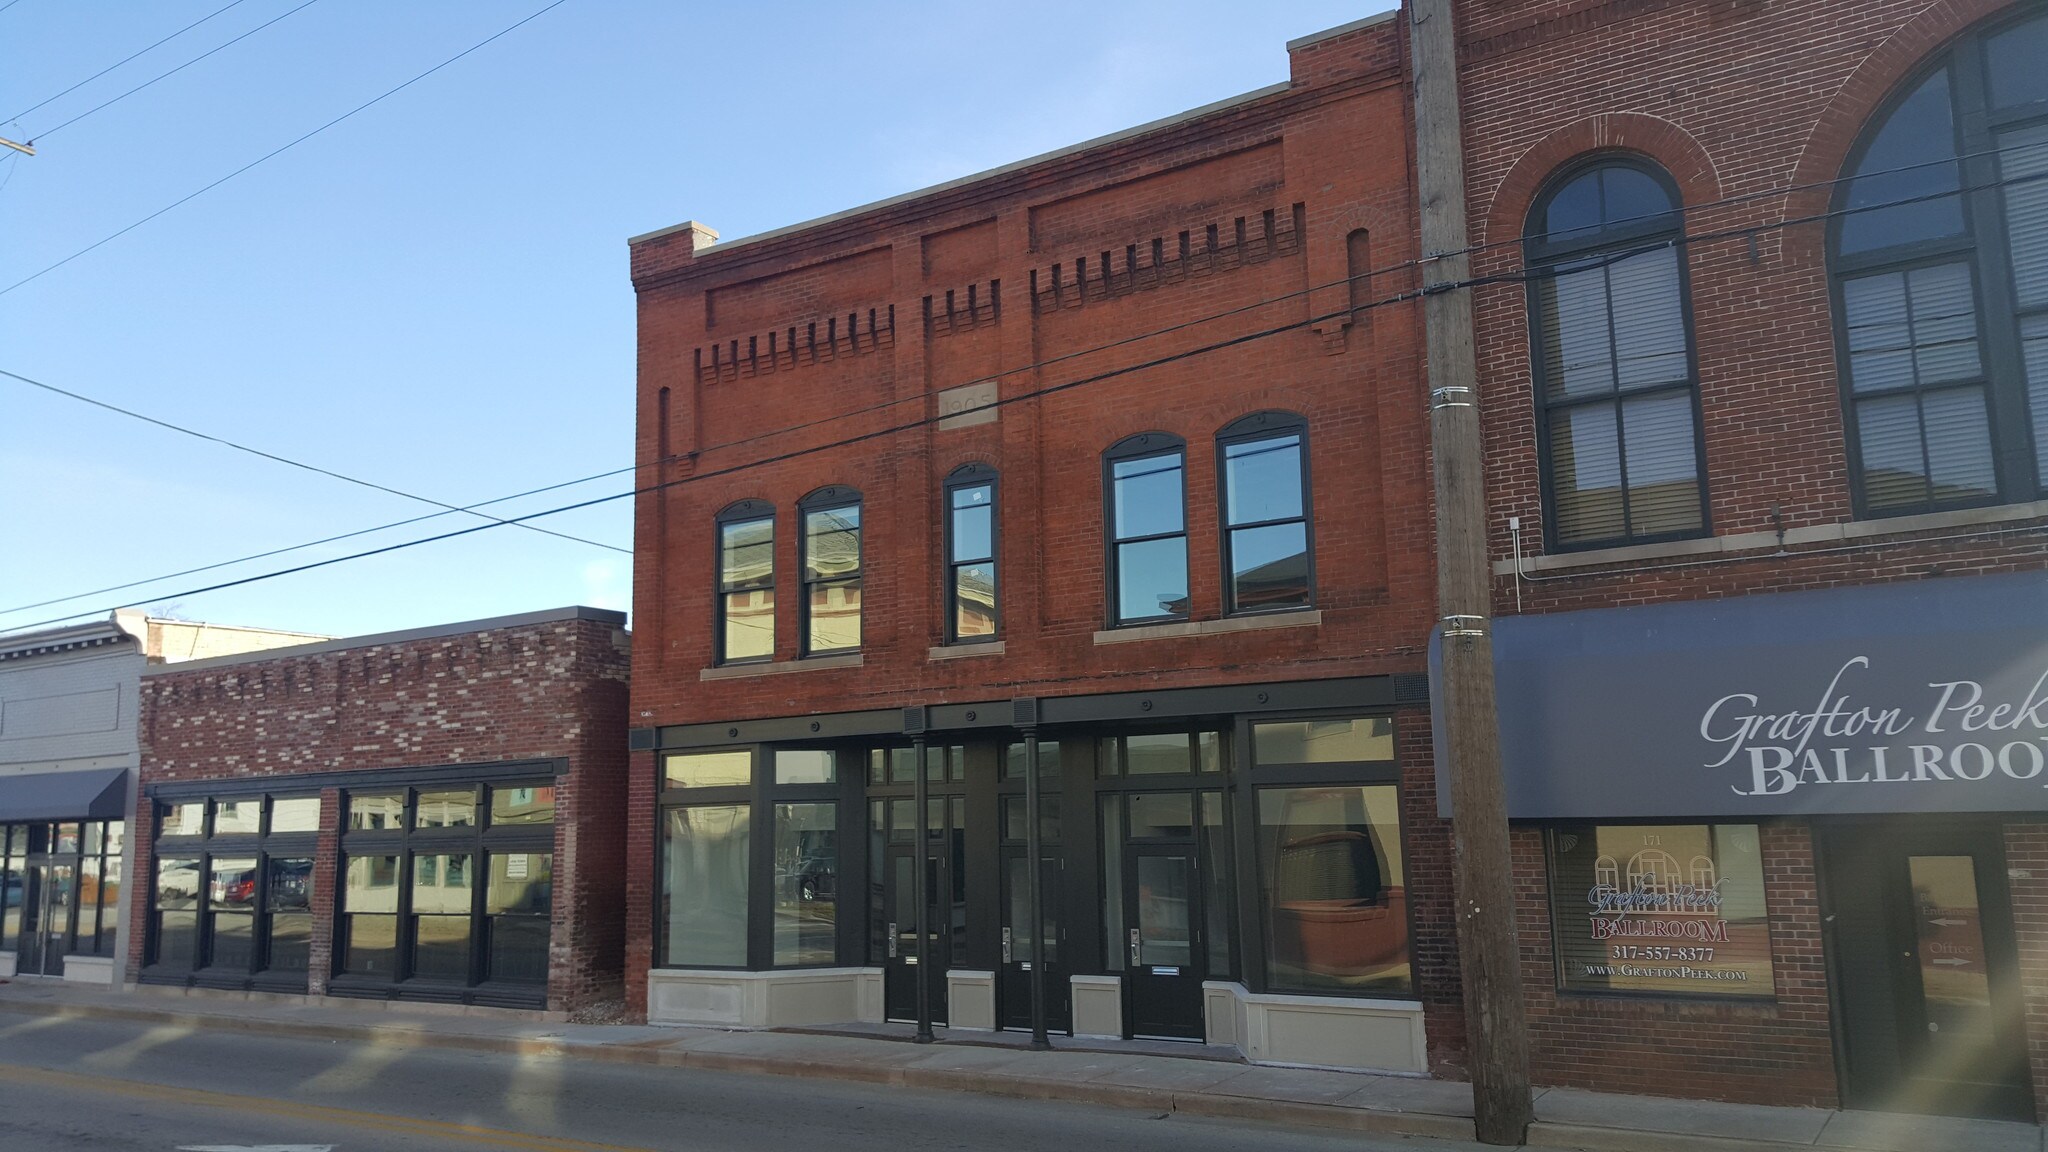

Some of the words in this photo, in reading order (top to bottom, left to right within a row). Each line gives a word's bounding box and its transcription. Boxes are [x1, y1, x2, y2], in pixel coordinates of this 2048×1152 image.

[944, 394, 992, 412] 1905
[1701, 656, 1914, 769] Grafton
[1925, 667, 2048, 734] Peek
[1744, 736, 2048, 796] BALLROO
[1643, 835, 1662, 846] 171
[1588, 871, 1671, 921] Grafton
[1674, 876, 1730, 908] Peek
[1590, 917, 1730, 943] BALLROOM
[1612, 945, 1714, 962] 317-557-8377
[1929, 942, 1974, 954] Office
